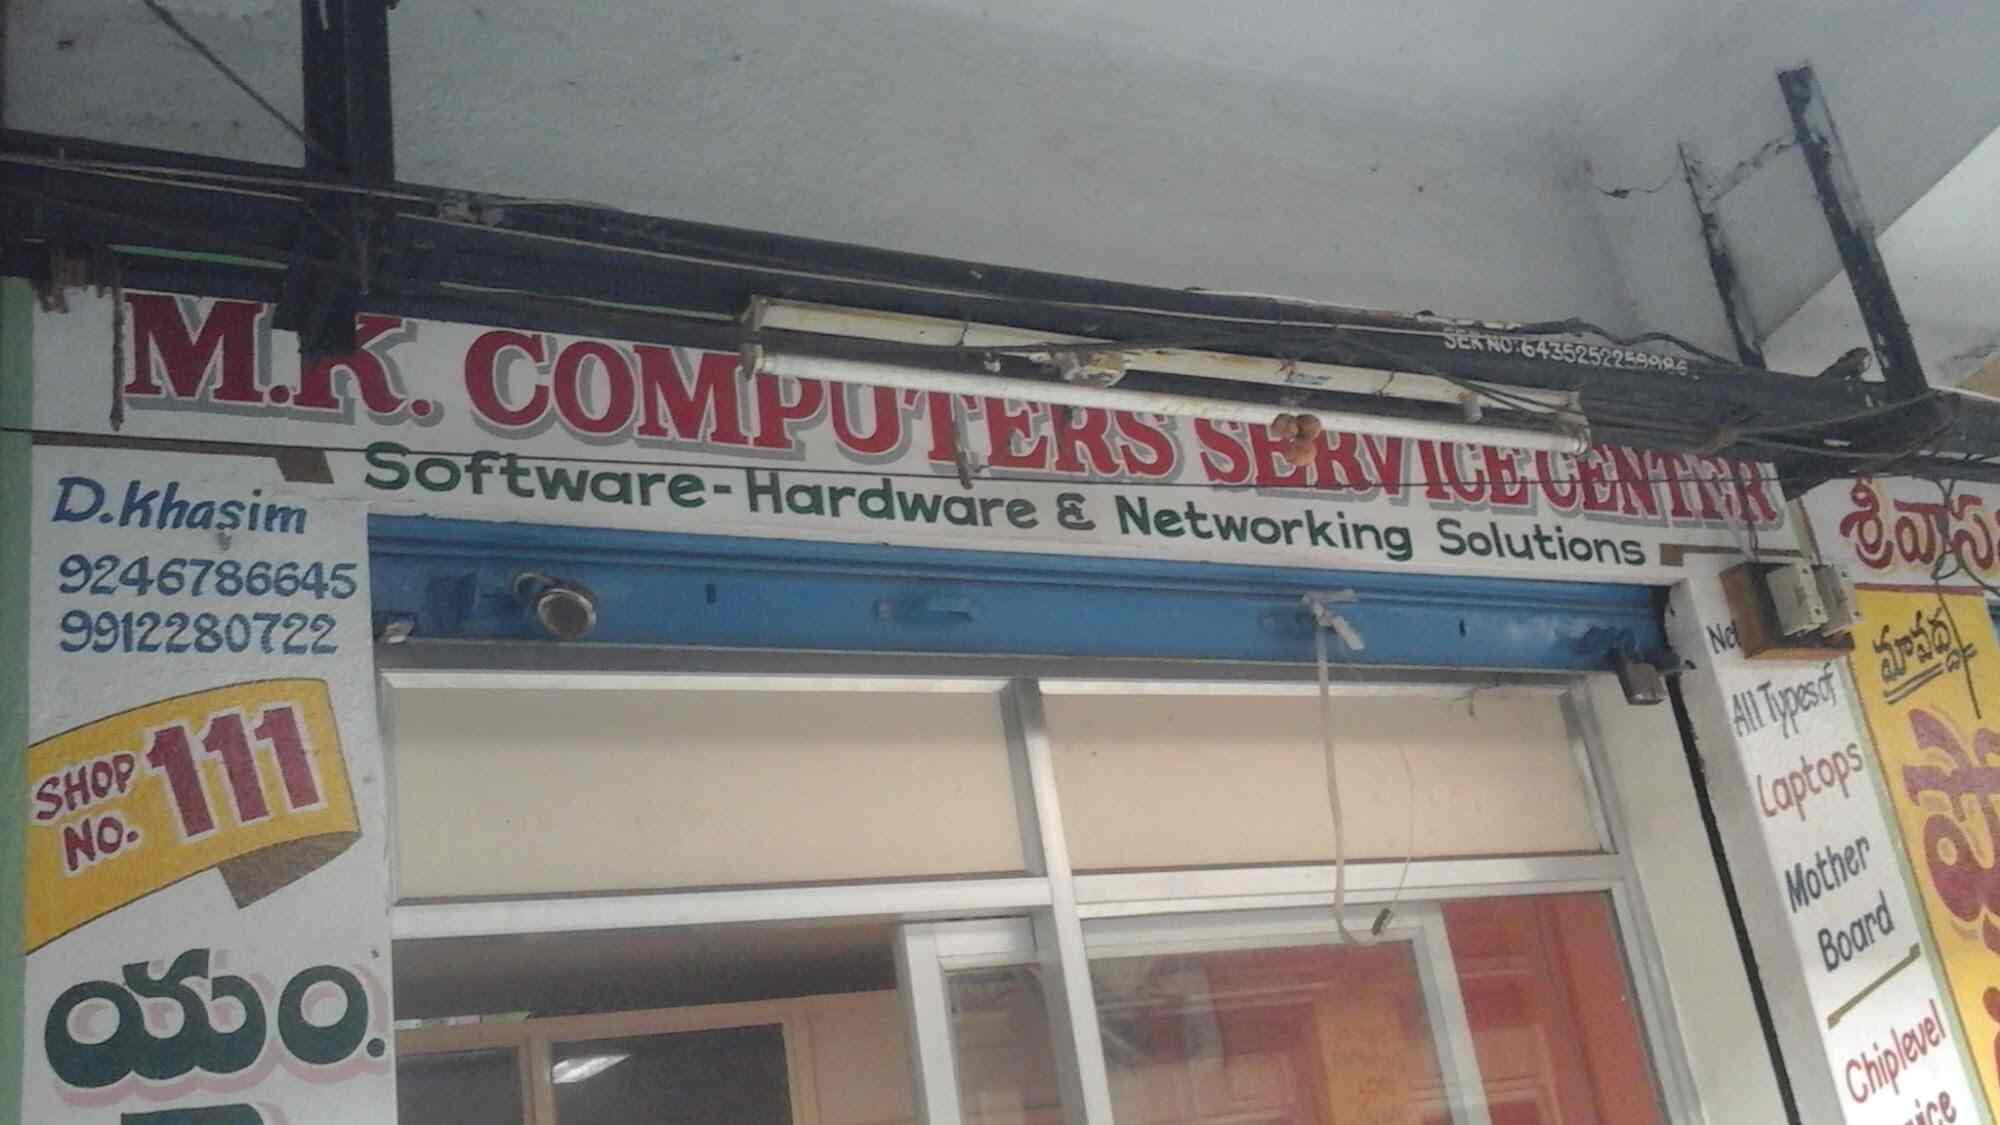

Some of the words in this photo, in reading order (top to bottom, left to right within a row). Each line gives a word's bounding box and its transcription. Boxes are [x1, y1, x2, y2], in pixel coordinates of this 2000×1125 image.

[464, 330, 1178, 478] COMPUTERS
[1195, 414, 1529, 505] SERVICE
[1056, 492, 1096, 531] &
[1114, 494, 1413, 562] Networking
[1437, 517, 1647, 567] Solutions
[58, 554, 358, 600] 9246786645
[59, 609, 339, 655] 9912280722
[1732, 689, 1765, 737] All
[36, 752, 136, 820] SHOP
[146, 706, 321, 838] 111
[1757, 742, 1864, 822] Laptops
[62, 815, 140, 872] NO.
[1784, 834, 1870, 914] Mother
[1816, 888, 1895, 973] Board
